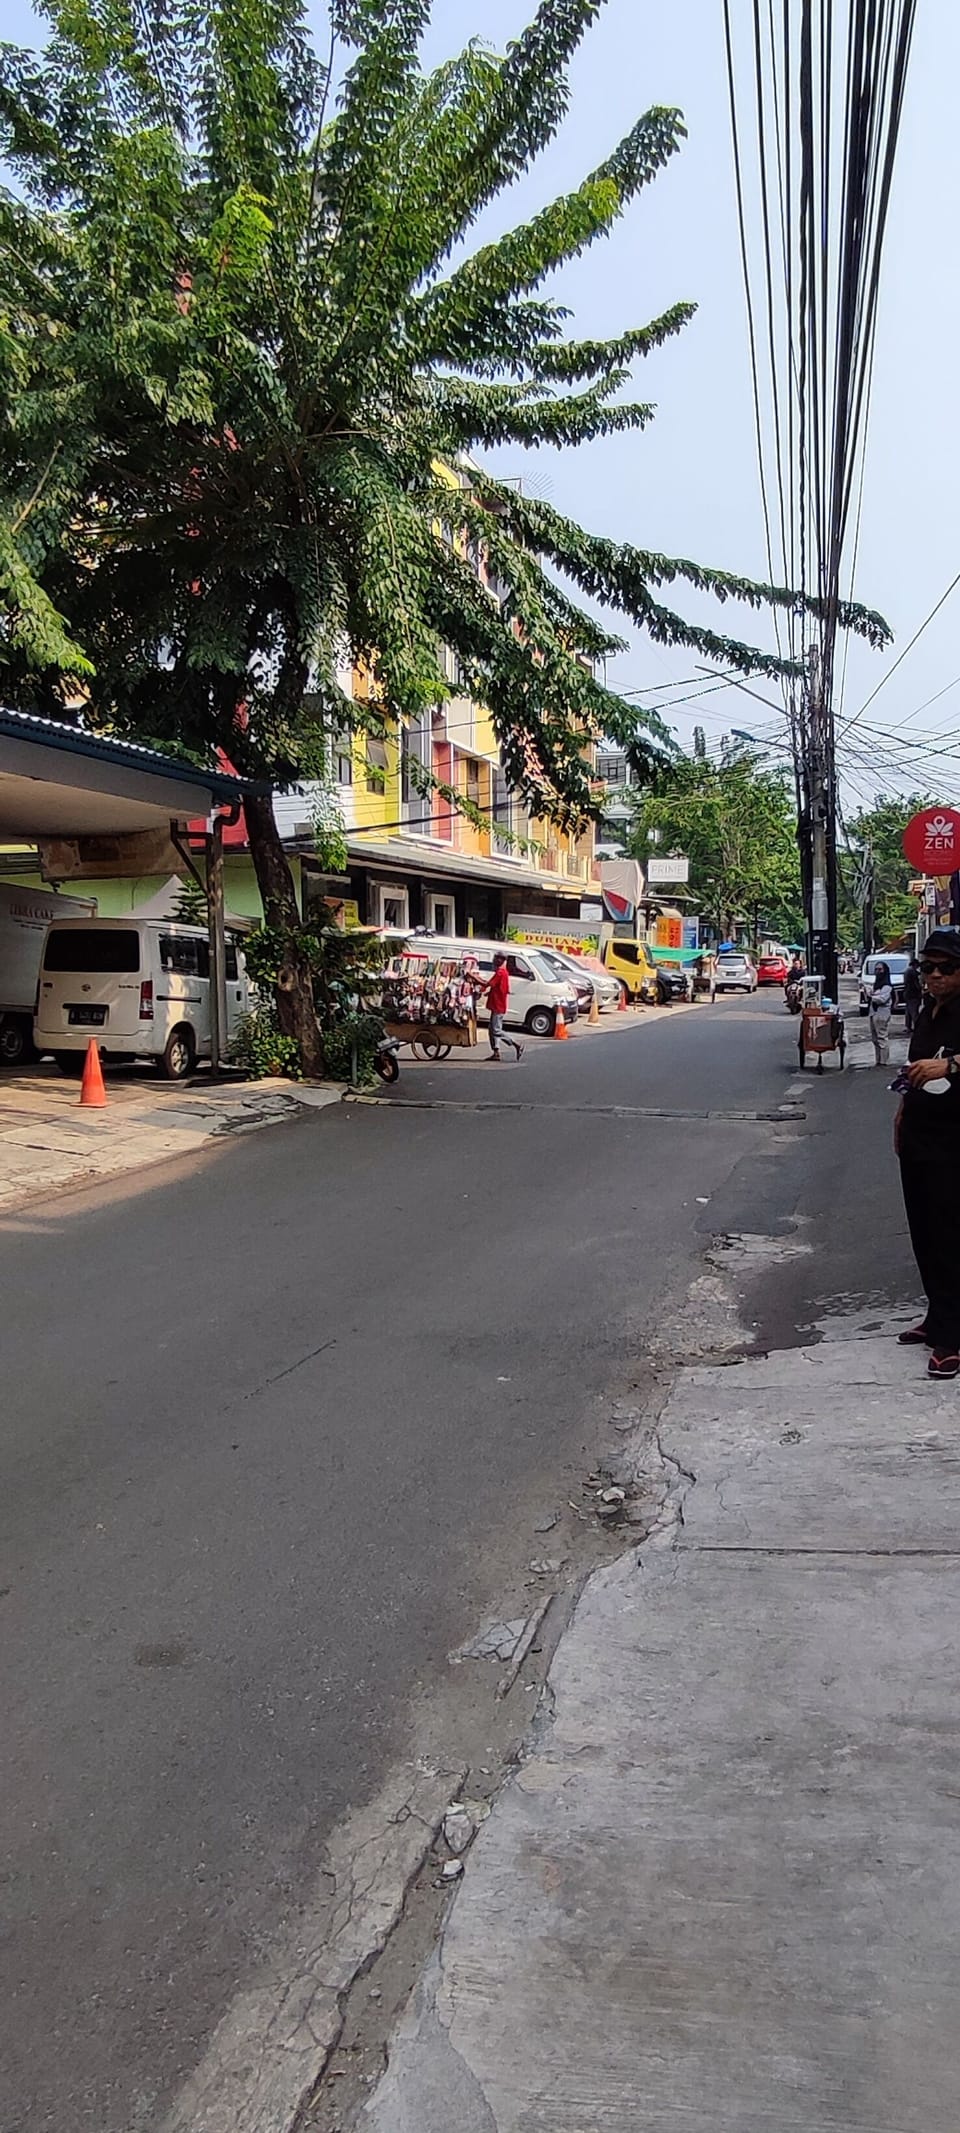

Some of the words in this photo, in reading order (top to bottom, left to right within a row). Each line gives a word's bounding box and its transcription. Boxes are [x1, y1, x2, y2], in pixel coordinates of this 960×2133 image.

[924, 837, 954, 849] ZEN
[651, 863, 684, 874] PRIME
[525, 935, 580, 945] DURIAN
